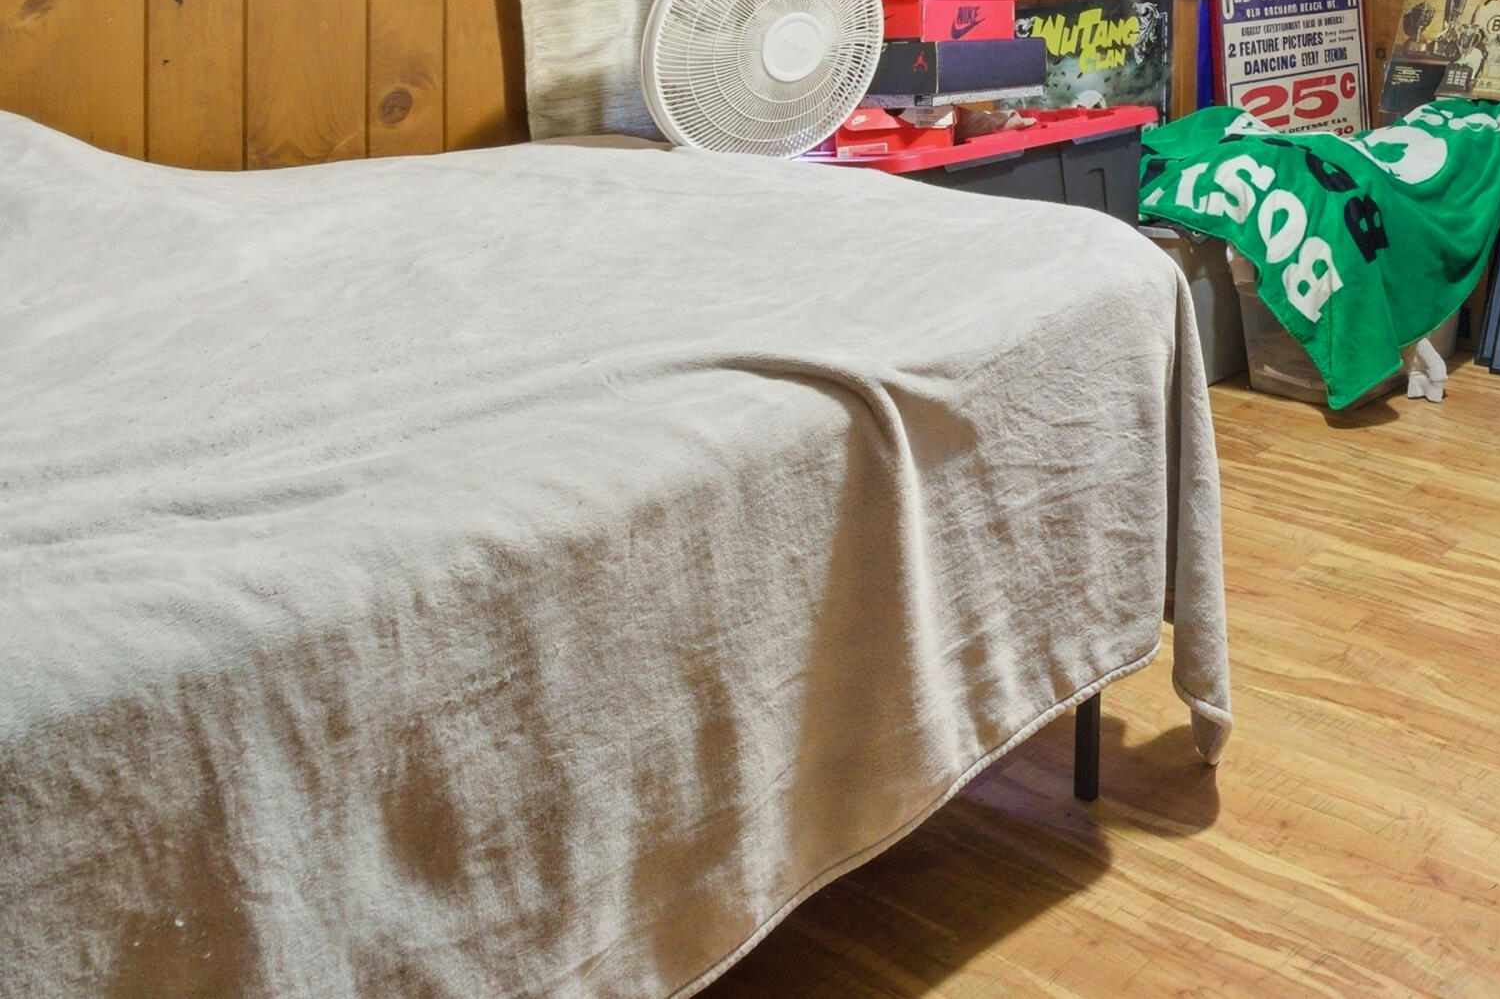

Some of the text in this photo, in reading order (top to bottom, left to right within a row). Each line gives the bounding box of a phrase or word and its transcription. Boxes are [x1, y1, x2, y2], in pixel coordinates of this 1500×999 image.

[956, 6, 981, 24] NIKE
[1246, 7, 1260, 19] OLD
[1264, 4, 1298, 16] ORCHARD
[1228, 43, 1237, 58] 2
[1240, 38, 1280, 57] FEATURE
[1282, 32, 1324, 50] PICTURES
[1243, 54, 1297, 76] DANCING
[1301, 51, 1319, 67] EVERY
[1289, 121, 1329, 134] DEFENSE
[1331, 117, 1348, 125] TAX
